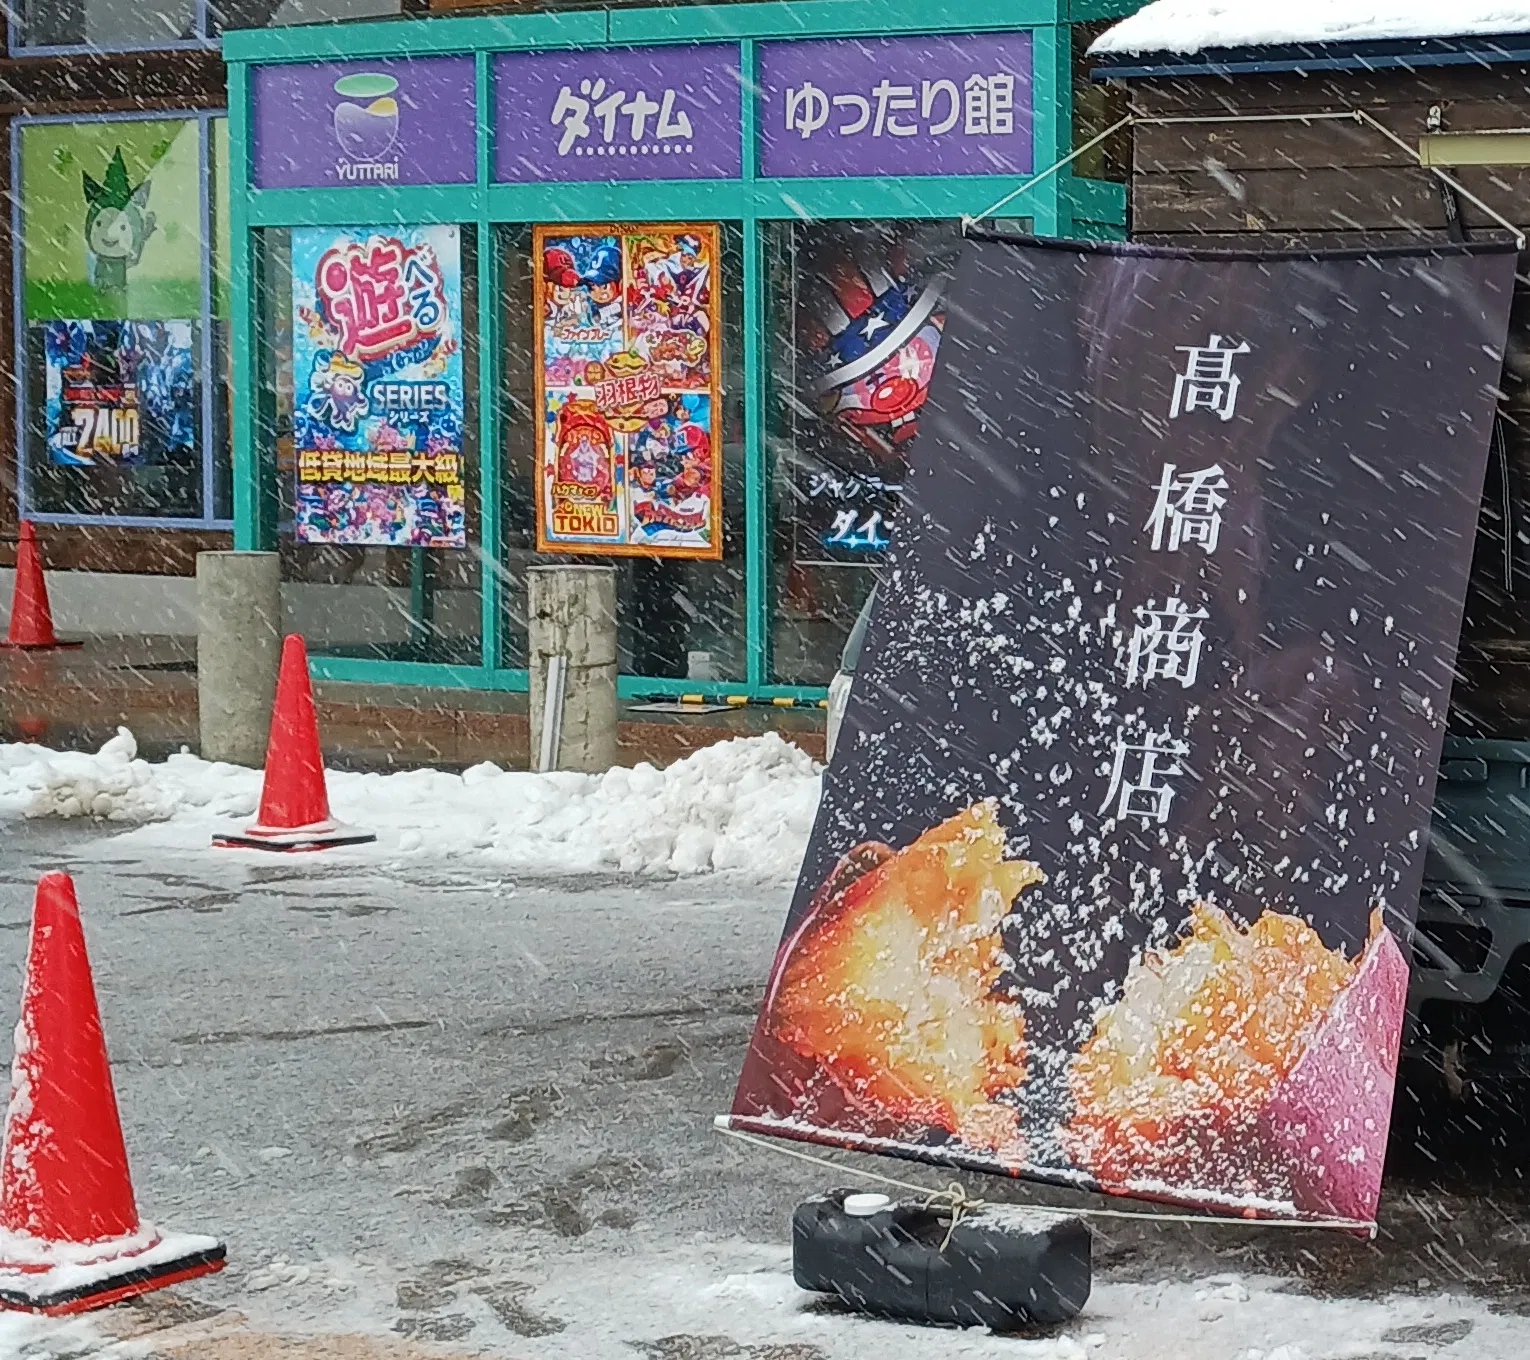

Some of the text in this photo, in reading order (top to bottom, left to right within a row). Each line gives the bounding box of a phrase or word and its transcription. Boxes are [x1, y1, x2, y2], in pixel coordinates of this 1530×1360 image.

[550, 77, 693, 156] ダイナム
[784, 73, 1015, 139] ゆったり館
[373, 383, 447, 411] SERIES
[595, 373, 661, 407] 羽根物
[388, 410, 430, 425] シリーズ
[555, 515, 616, 533] TOKIO
[830, 509, 895, 543] ダイ
